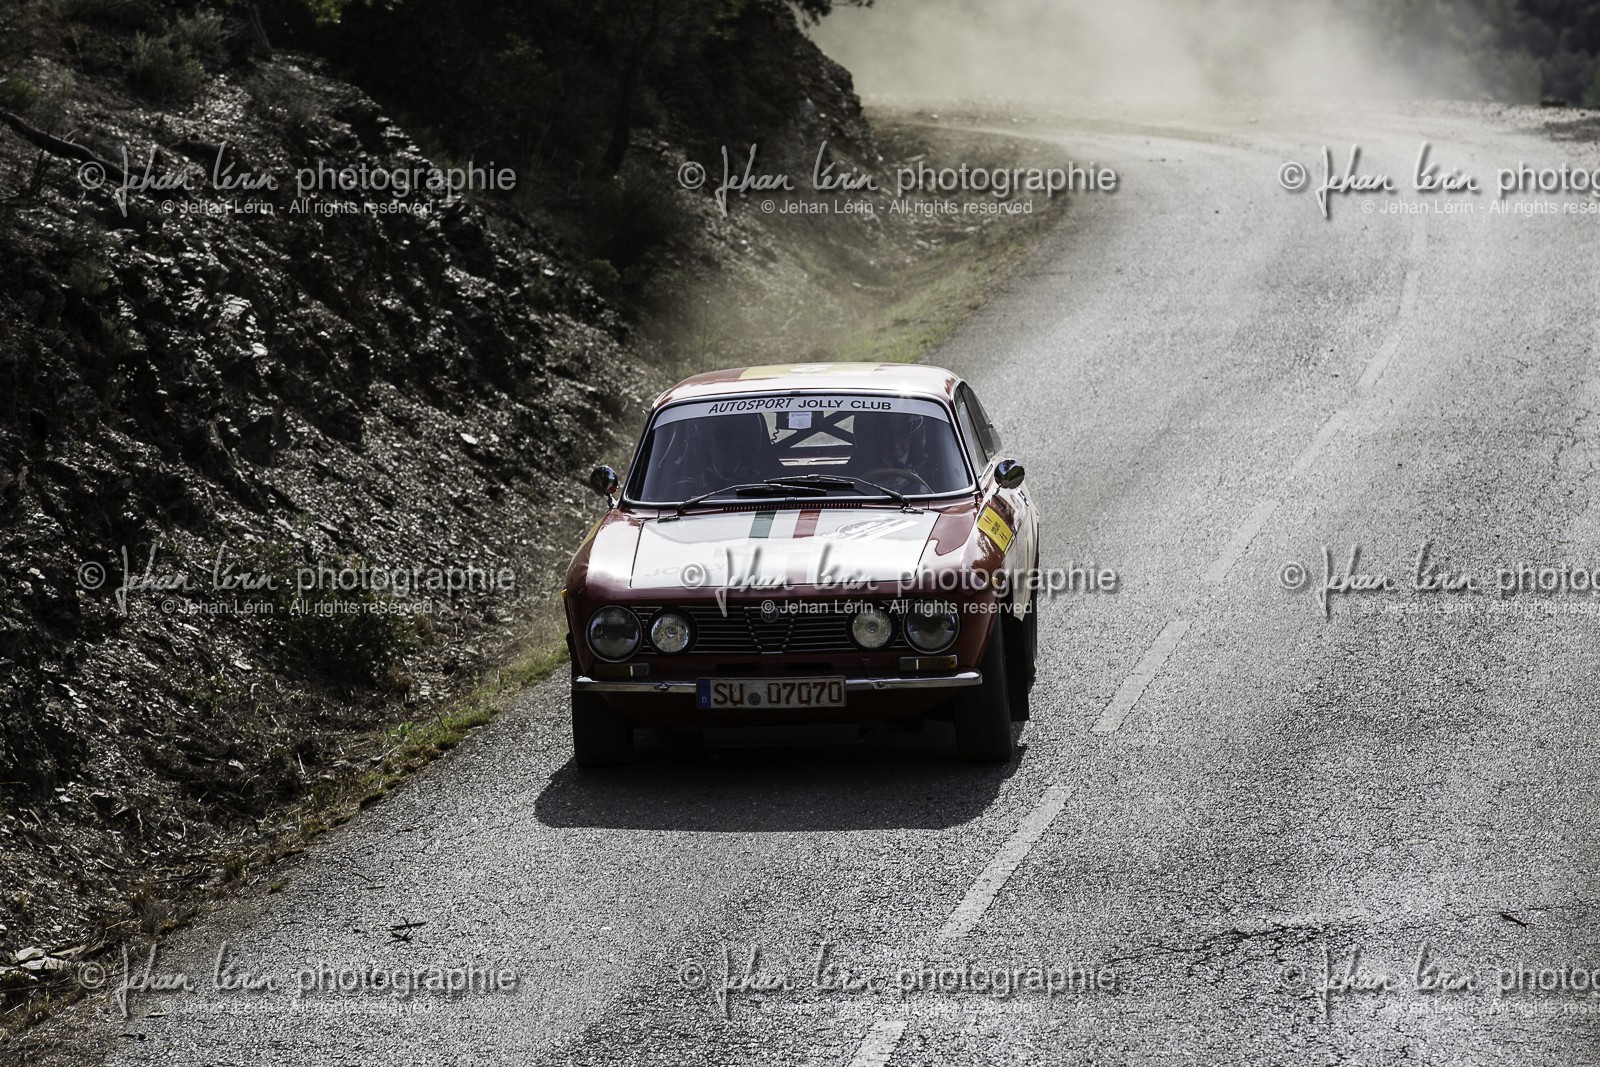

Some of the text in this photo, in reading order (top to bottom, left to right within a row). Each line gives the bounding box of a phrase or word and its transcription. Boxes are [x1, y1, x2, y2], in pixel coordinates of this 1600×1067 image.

[708, 398, 892, 414] AUTOSPORT JOLLY CLUB
[713, 681, 843, 705] SU 07070
